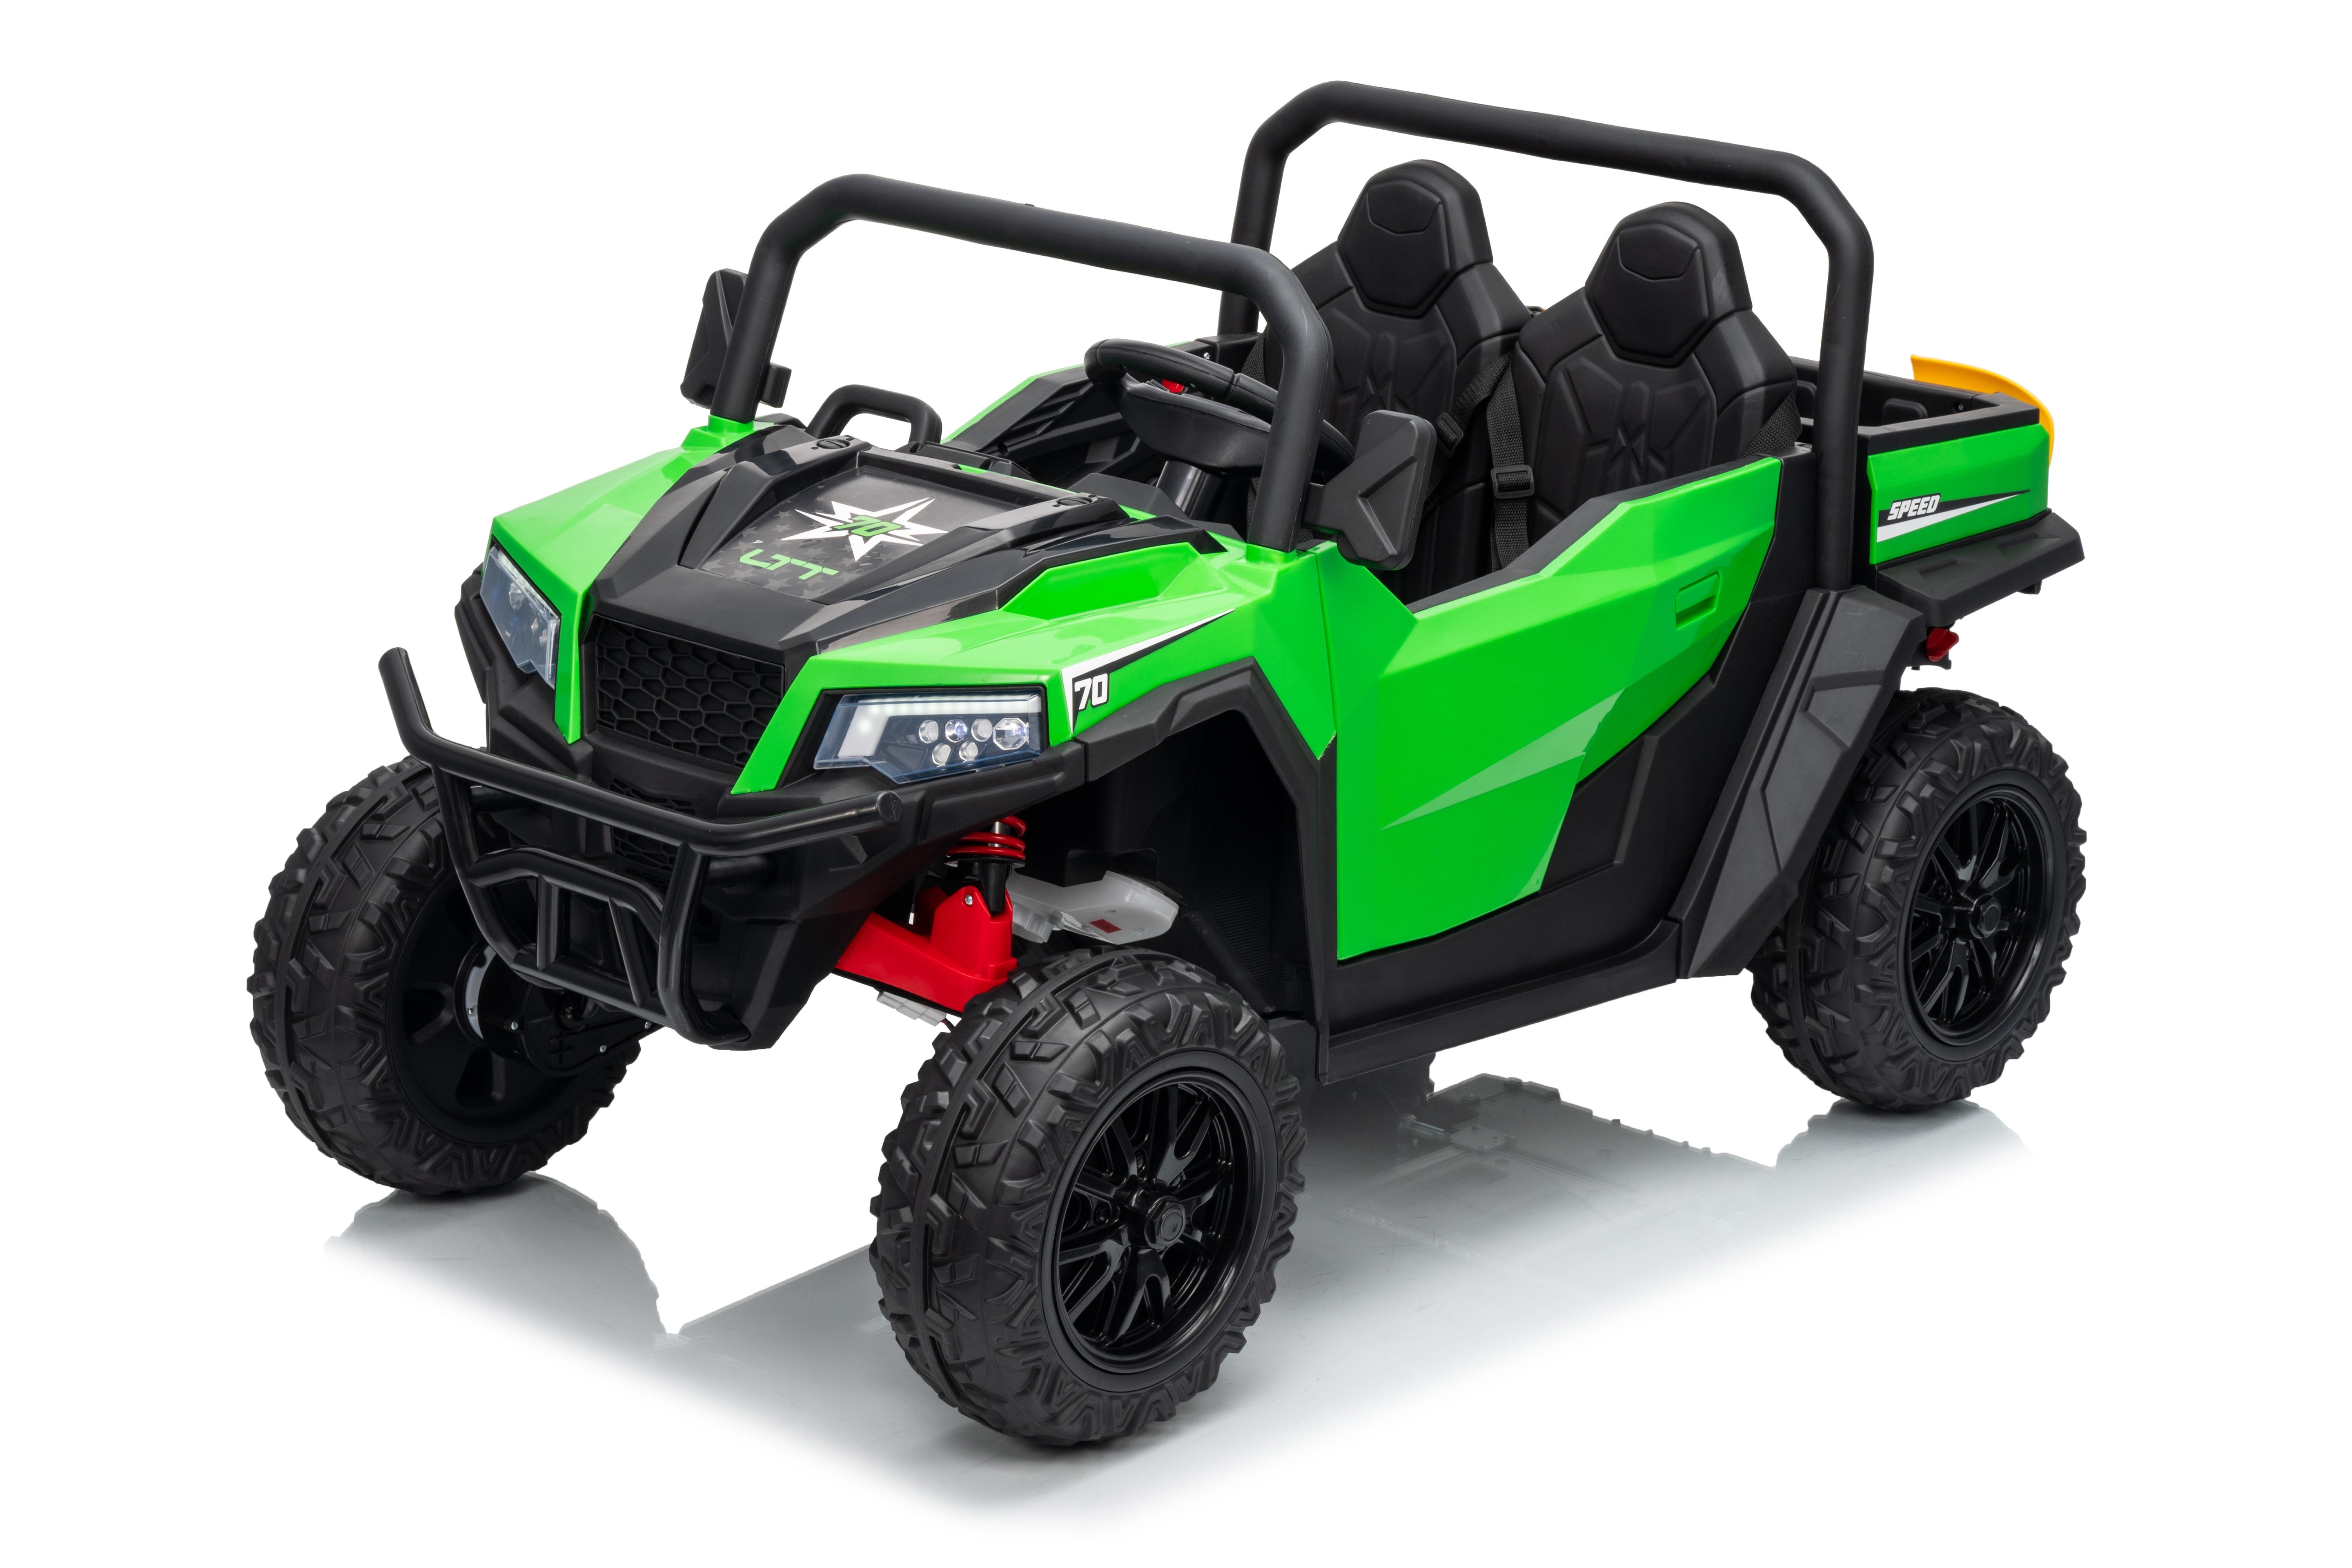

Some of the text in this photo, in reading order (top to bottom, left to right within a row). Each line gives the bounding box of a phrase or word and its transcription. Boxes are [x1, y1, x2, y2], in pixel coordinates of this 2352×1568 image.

[1887, 495, 1940, 521] SPEED
[834, 515, 901, 537] 70
[1074, 673, 1108, 710] 70
